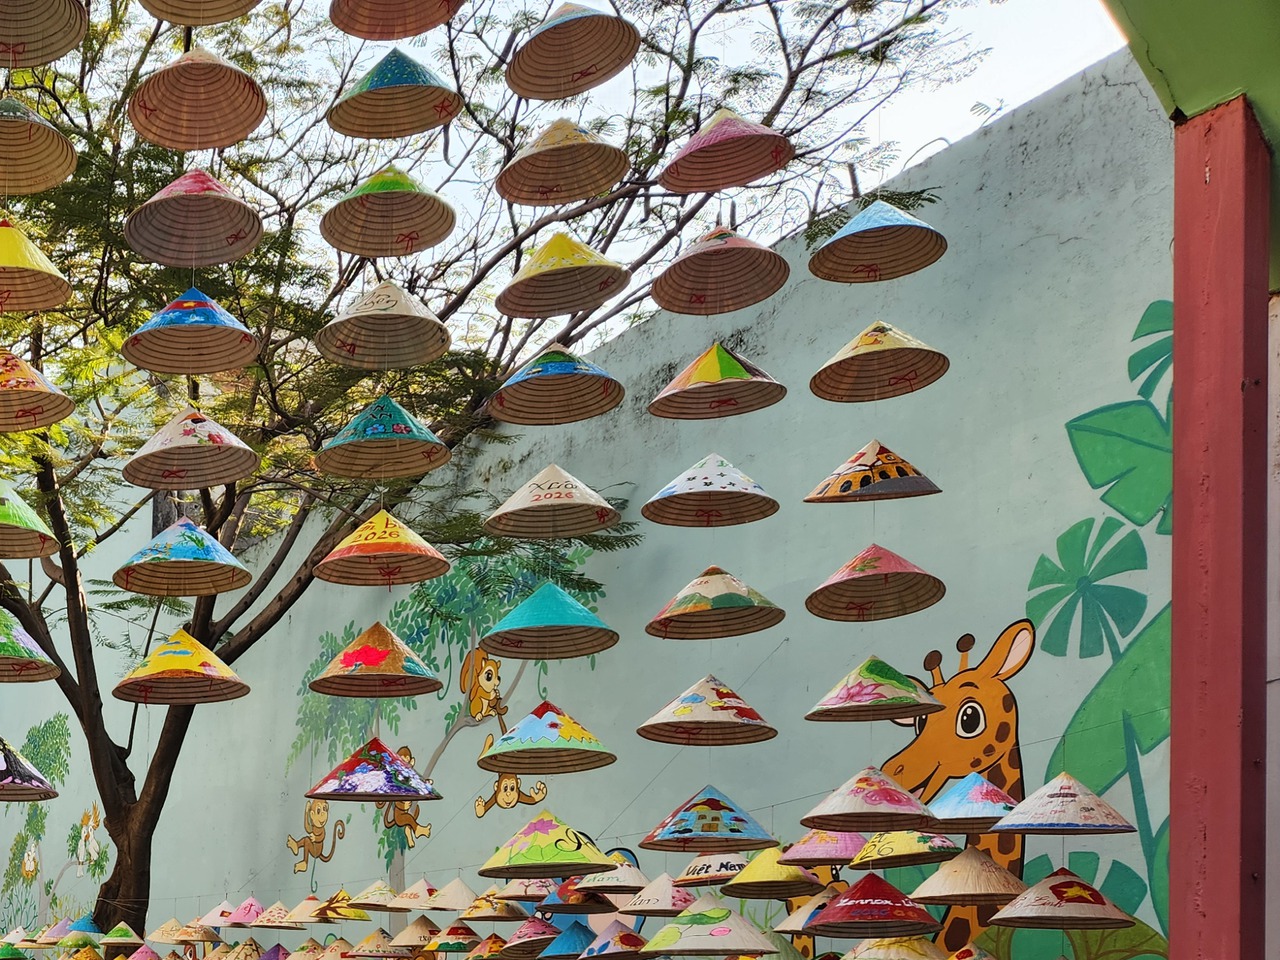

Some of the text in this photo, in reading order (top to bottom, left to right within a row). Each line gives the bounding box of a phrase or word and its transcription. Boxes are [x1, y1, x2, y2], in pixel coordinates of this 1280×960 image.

[530, 491, 574, 502] 2026
[351, 530, 400, 543] 2026
[685, 863, 712, 877] Việt
